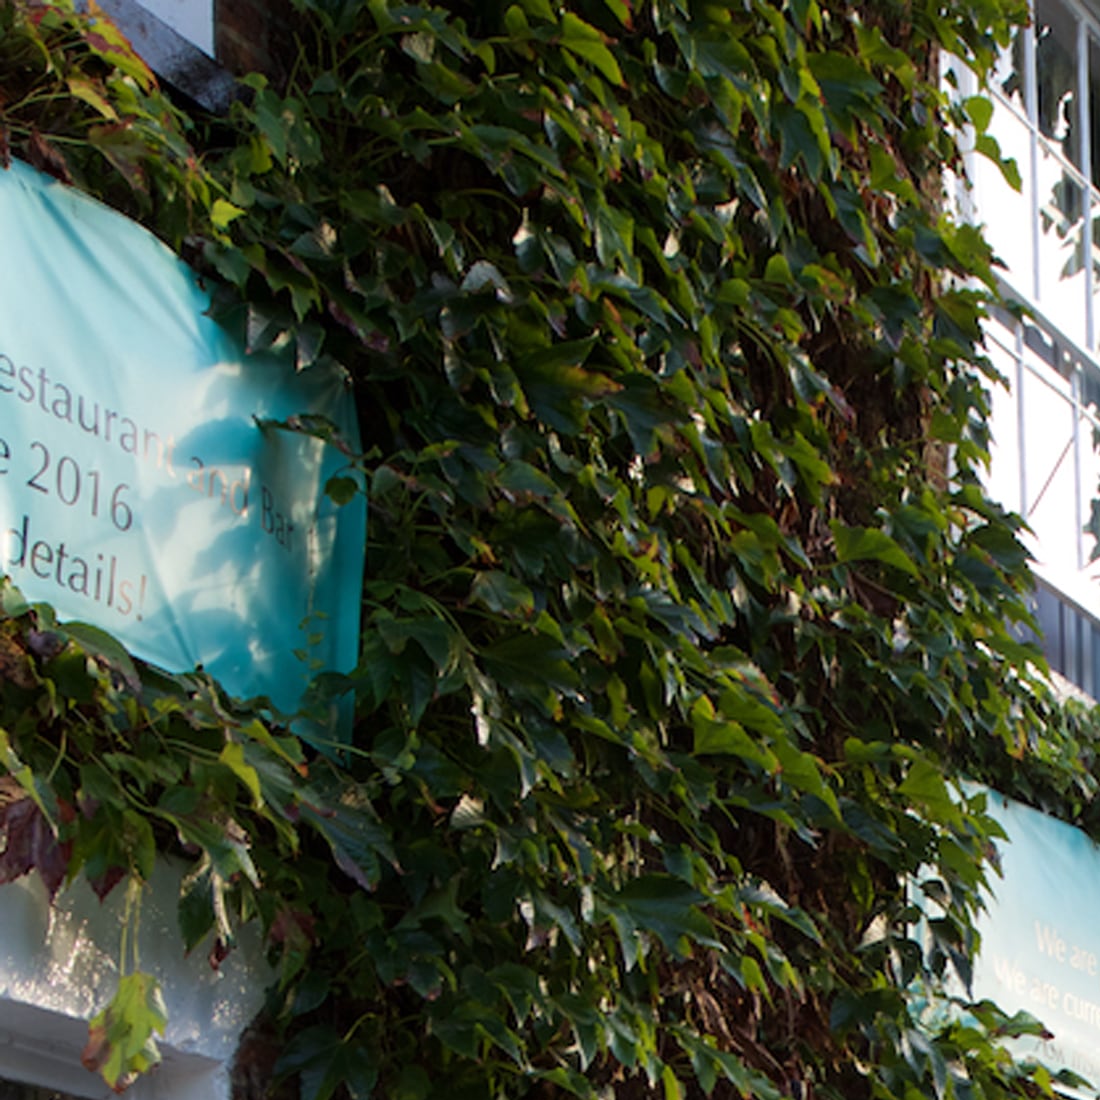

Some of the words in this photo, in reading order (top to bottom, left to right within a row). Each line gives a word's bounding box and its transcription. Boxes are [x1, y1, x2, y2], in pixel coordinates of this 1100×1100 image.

[27, 440, 133, 533] 2016
[186, 456, 251, 519] and
[262, 484, 295, 552] Bar
[5, 514, 147, 623] details!
[1033, 918, 1066, 963] We
[1069, 946, 1098, 977] are
